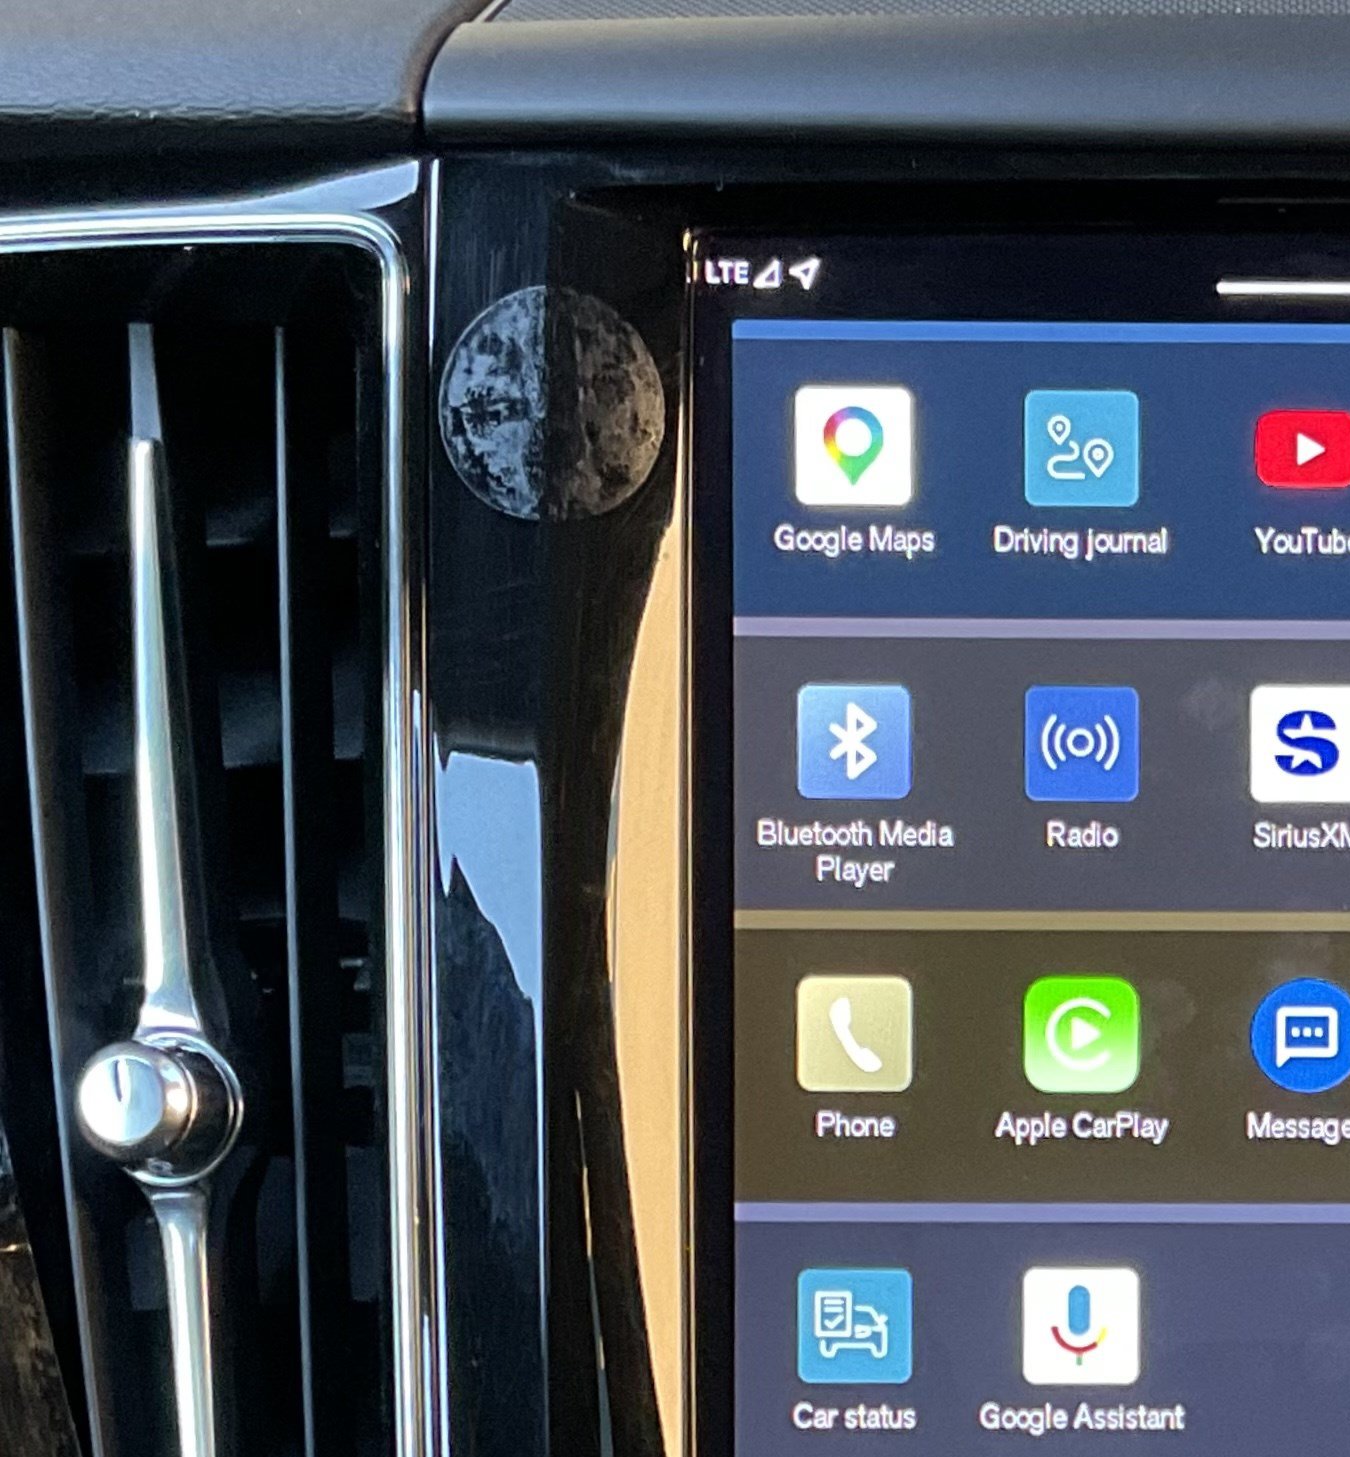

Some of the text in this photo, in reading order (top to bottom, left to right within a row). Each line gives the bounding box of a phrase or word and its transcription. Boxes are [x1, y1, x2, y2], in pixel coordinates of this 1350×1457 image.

[705, 259, 750, 285] LTE
[773, 523, 935, 560] Google Maps
[993, 524, 1168, 562] Driving journal
[757, 818, 954, 848] Bluetooth Media
[1047, 820, 1119, 848] Radio
[816, 853, 896, 888] Player
[816, 1109, 896, 1138] Phone
[994, 1110, 1170, 1146] Apple CarPlay
[792, 1401, 917, 1430] Car status
[979, 1401, 1186, 1437] Google Assistant
